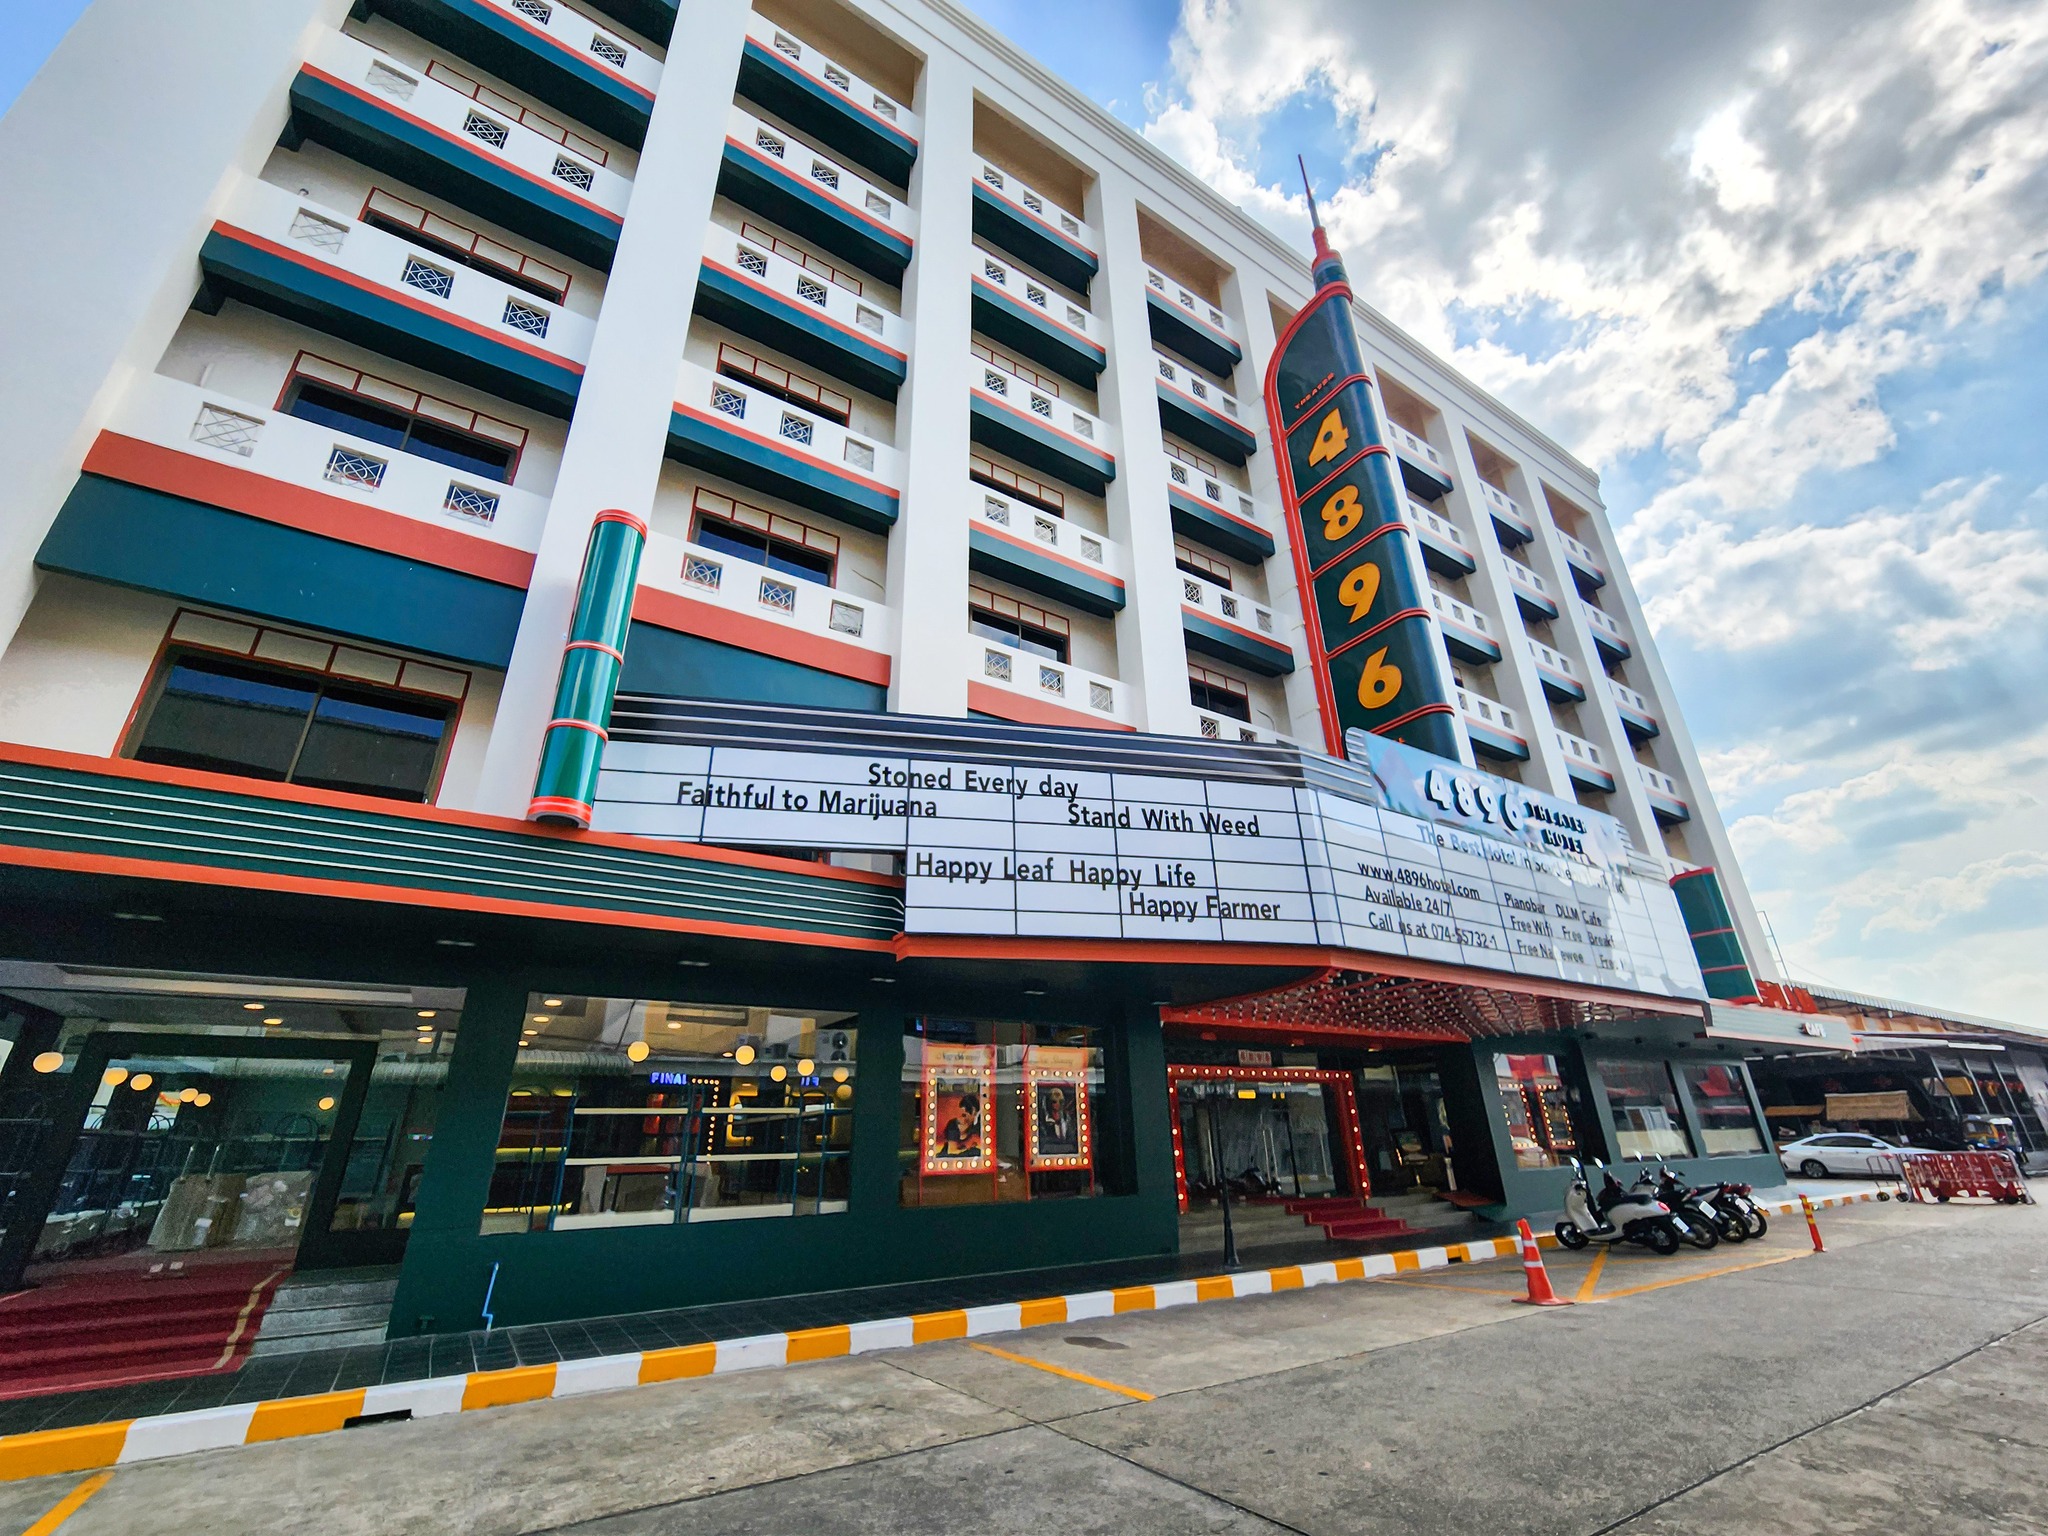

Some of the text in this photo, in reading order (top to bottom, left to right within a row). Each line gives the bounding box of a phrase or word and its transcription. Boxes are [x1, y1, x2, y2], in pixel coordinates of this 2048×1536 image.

[1308, 407, 1402, 709] 4896
[868, 762, 1078, 802] Stoned Every day
[677, 781, 937, 820] Faithful to Marijuana
[1425, 769, 1524, 831] 4896
[1068, 803, 1260, 836] Stand With Weed
[916, 852, 1196, 890] Happy Leaf Happy Life
[1358, 862, 1481, 900] www.4896hotel.com
[1129, 892, 1280, 922] Happy Farmer
[1365, 885, 1450, 916] Available 24/7
[1504, 892, 1545, 914] Pianobar
[1368, 911, 1394, 932] Call
[1399, 921, 1412, 936] us
[1416, 923, 1429, 938] at
[1510, 915, 1531, 932] Free
[1532, 920, 1553, 937] Wifi
[1562, 926, 1582, 942] Free
[1517, 939, 1538, 956] Free
[651, 1071, 688, 1085] FINAL
